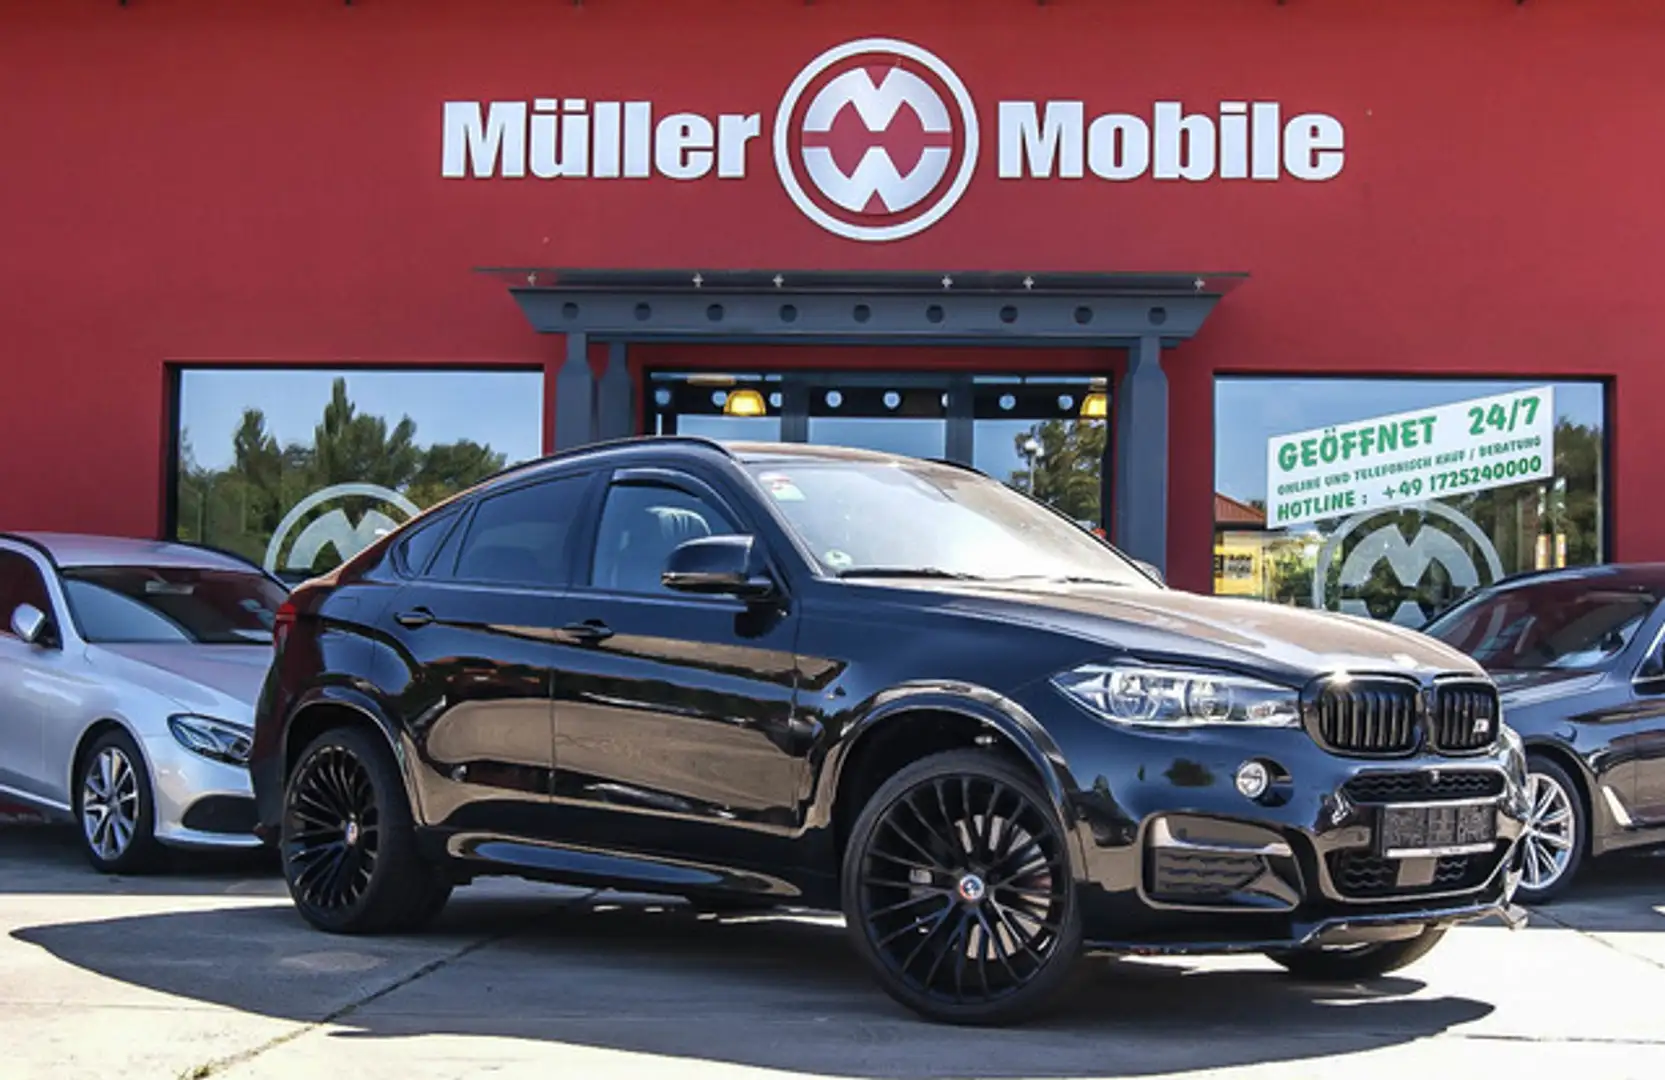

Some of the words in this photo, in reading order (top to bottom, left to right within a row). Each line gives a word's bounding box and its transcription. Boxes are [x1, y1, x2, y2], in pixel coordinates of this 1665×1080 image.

[442, 98, 760, 180] Müller
[998, 100, 1345, 180] Mobile
[1277, 415, 1437, 471] GEÖFFNET
[1467, 396, 1541, 435] 24/7
[1277, 476, 1321, 495] ONLINE
[1324, 471, 1352, 487] UND
[1354, 456, 1432, 481] TELEFONISCH
[1435, 449, 1466, 465] KAUF
[1478, 435, 1541, 458] BERATUNG
[1277, 489, 1356, 521] HOTLINE
[1382, 478, 1422, 499] +49
[1430, 454, 1542, 492] 1725240000
